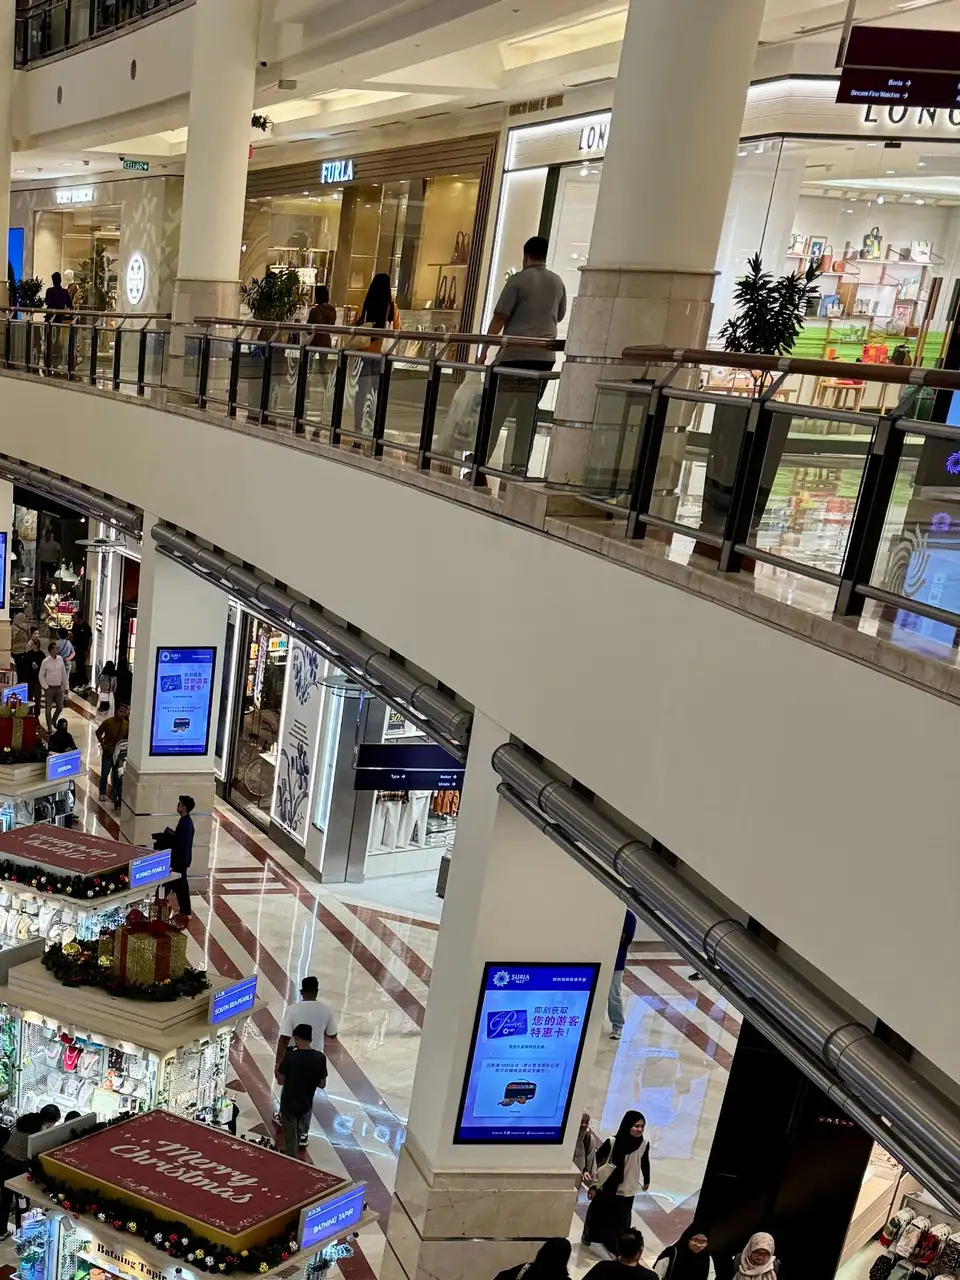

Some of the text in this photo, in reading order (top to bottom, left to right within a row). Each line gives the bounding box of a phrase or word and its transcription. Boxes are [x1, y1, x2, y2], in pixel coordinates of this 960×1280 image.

[321, 159, 353, 184] FURLA
[531, 1015, 580, 1027] 您的游客
[533, 1006, 569, 1015] 即刻获取
[109, 1145, 253, 1203] Christmas
[156, 1140, 259, 1187] Merry
[313, 1207, 355, 1234] BATHING TAPIR
